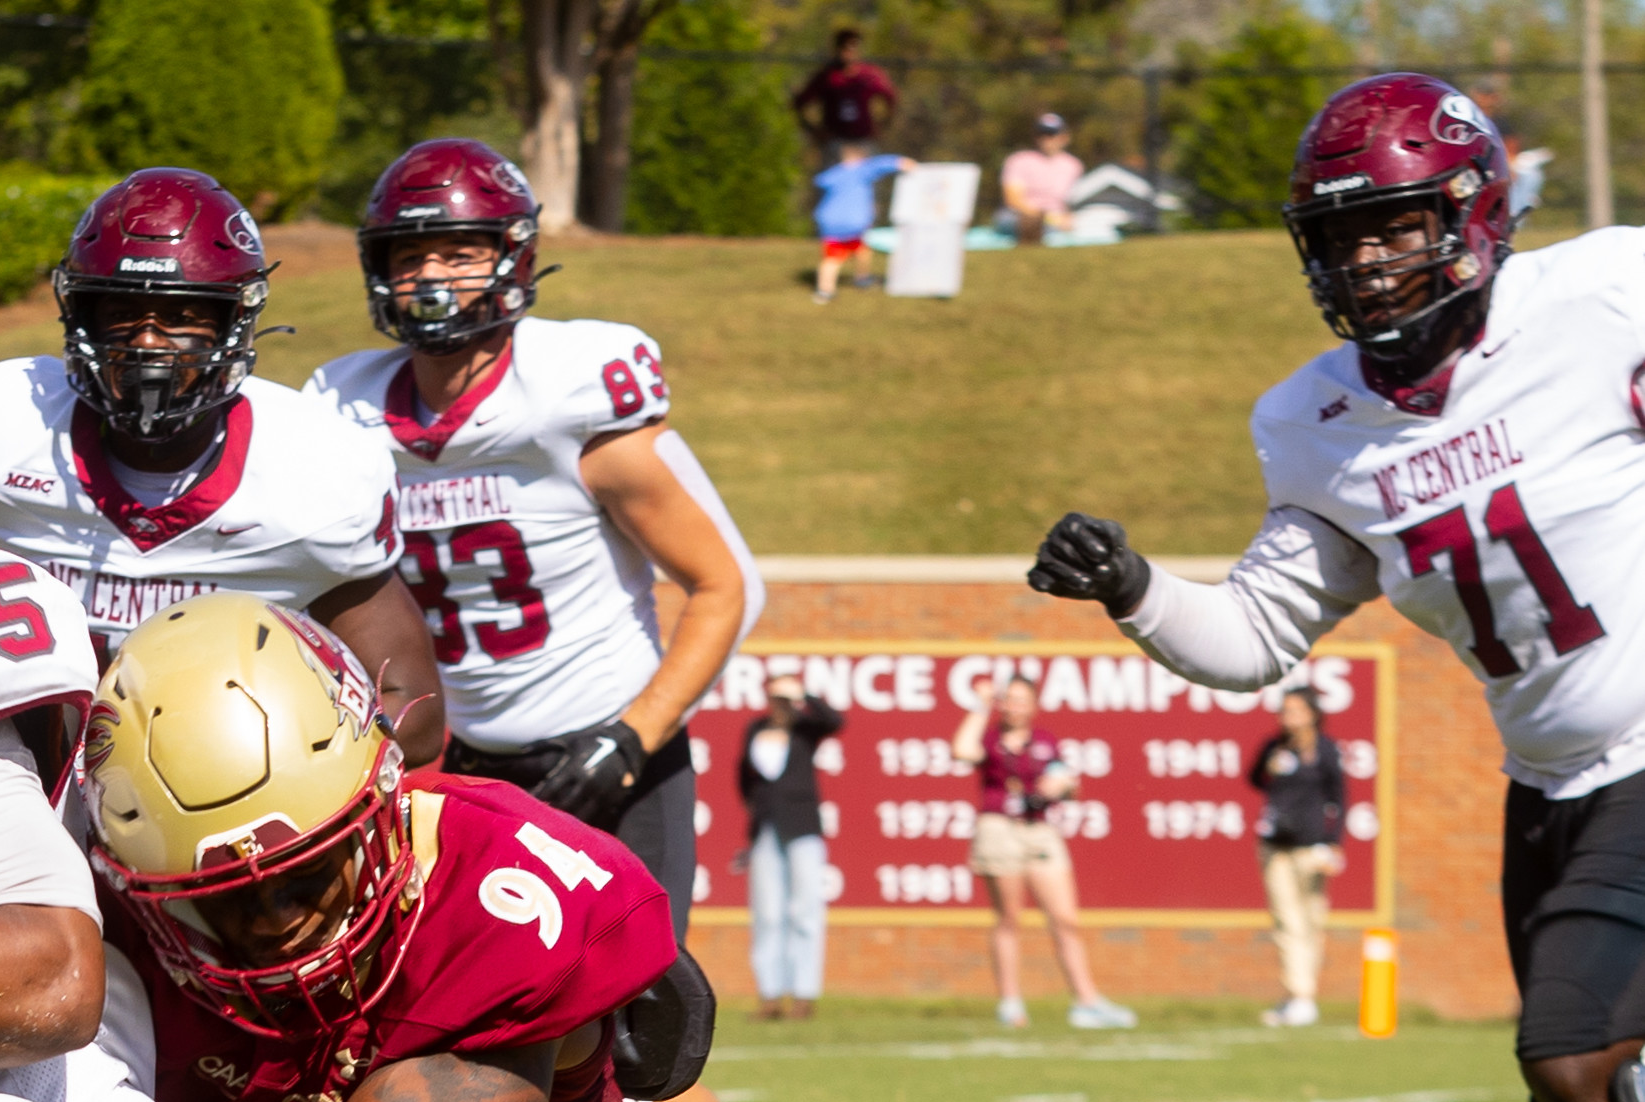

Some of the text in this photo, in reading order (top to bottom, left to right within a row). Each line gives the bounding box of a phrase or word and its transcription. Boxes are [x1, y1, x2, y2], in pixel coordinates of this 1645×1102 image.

[601, 343, 668, 419] 83
[4, 471, 55, 494] MEAC
[1372, 418, 1525, 521] NC CENTRAL
[403, 518, 552, 665] 83
[1395, 480, 1608, 679] 71
[477, 821, 615, 951] 94
